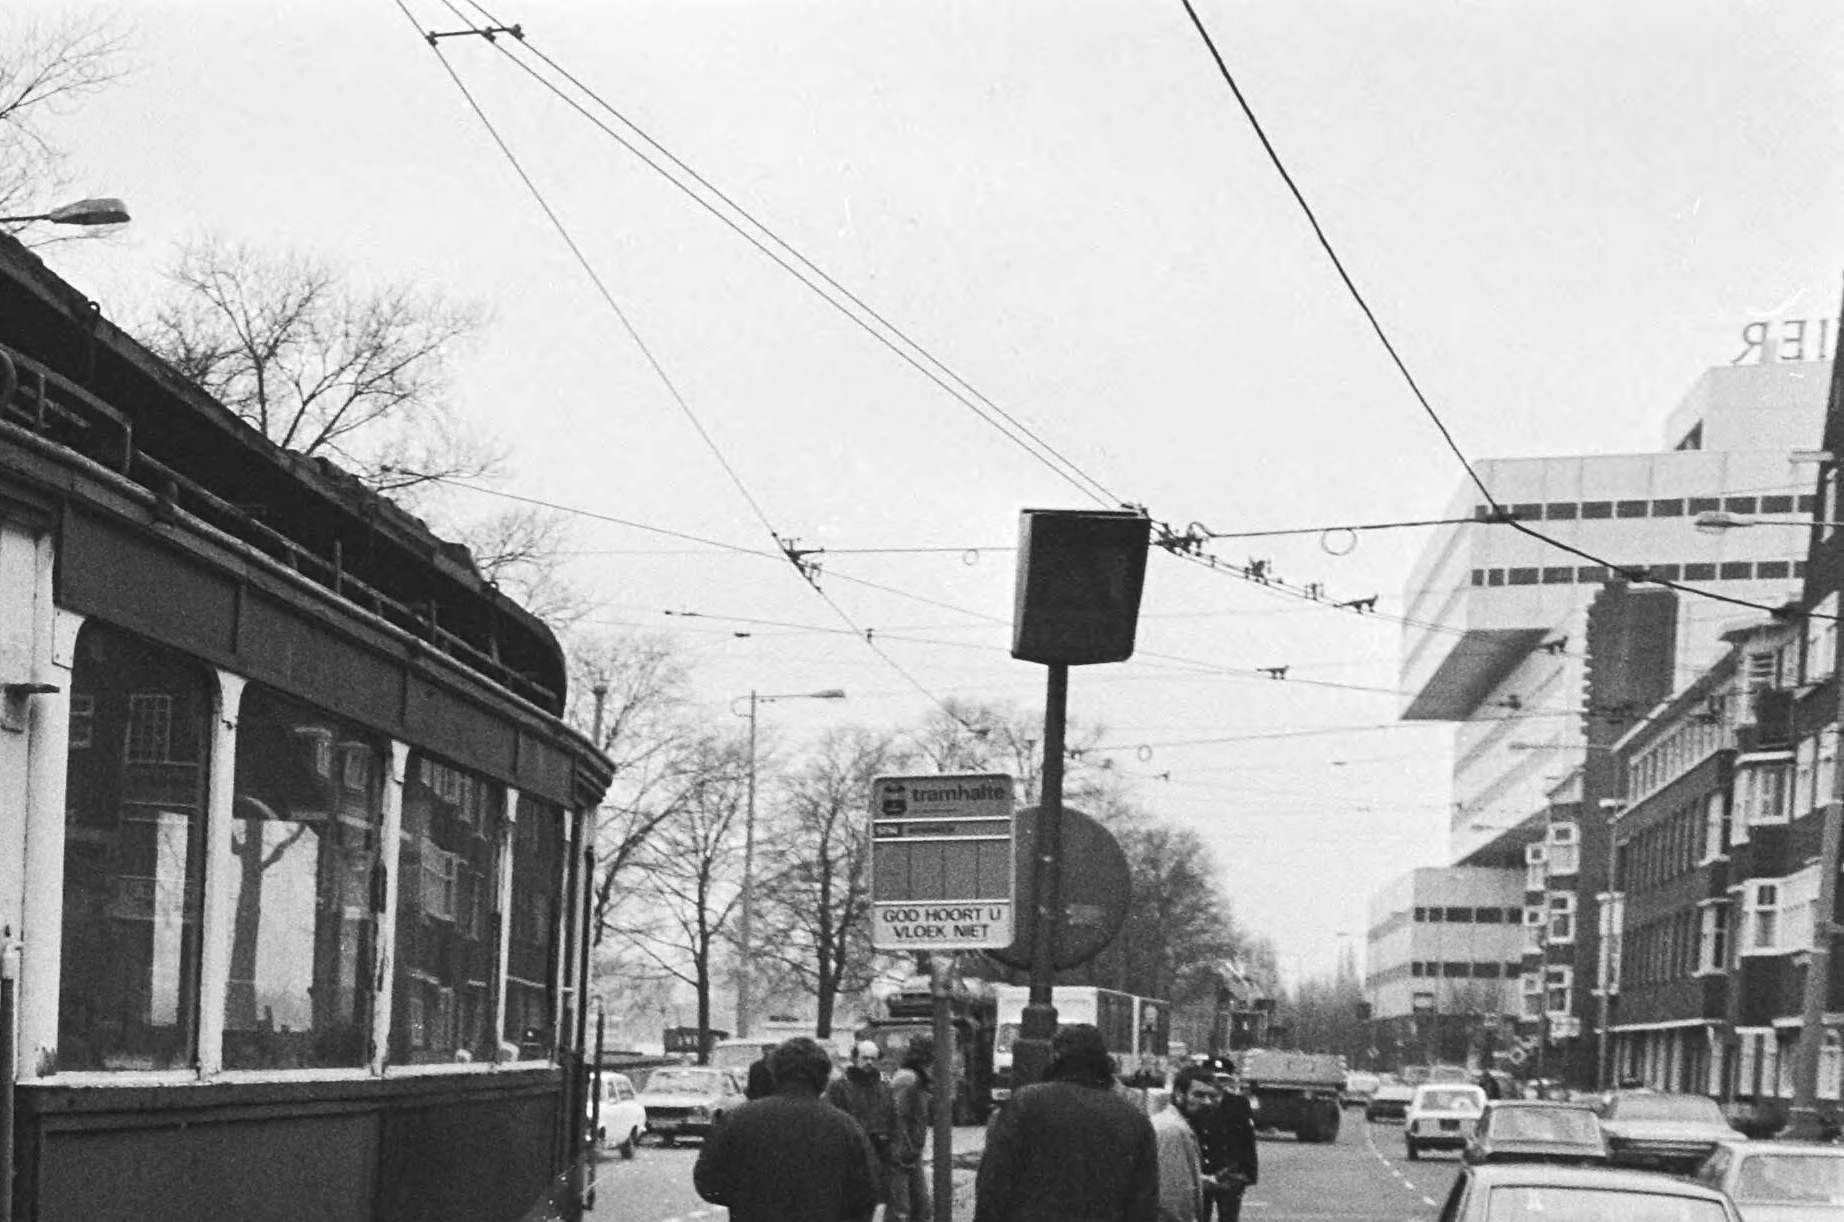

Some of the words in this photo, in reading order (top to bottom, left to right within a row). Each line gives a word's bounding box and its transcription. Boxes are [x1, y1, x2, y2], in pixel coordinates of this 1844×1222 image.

[912, 784, 1005, 801] tramhalte
[883, 908, 920, 923] GOD
[925, 908, 982, 922] HOORT
[989, 908, 1002, 921] U
[893, 924, 946, 938] VLOEK
[953, 924, 989, 938] NIET
